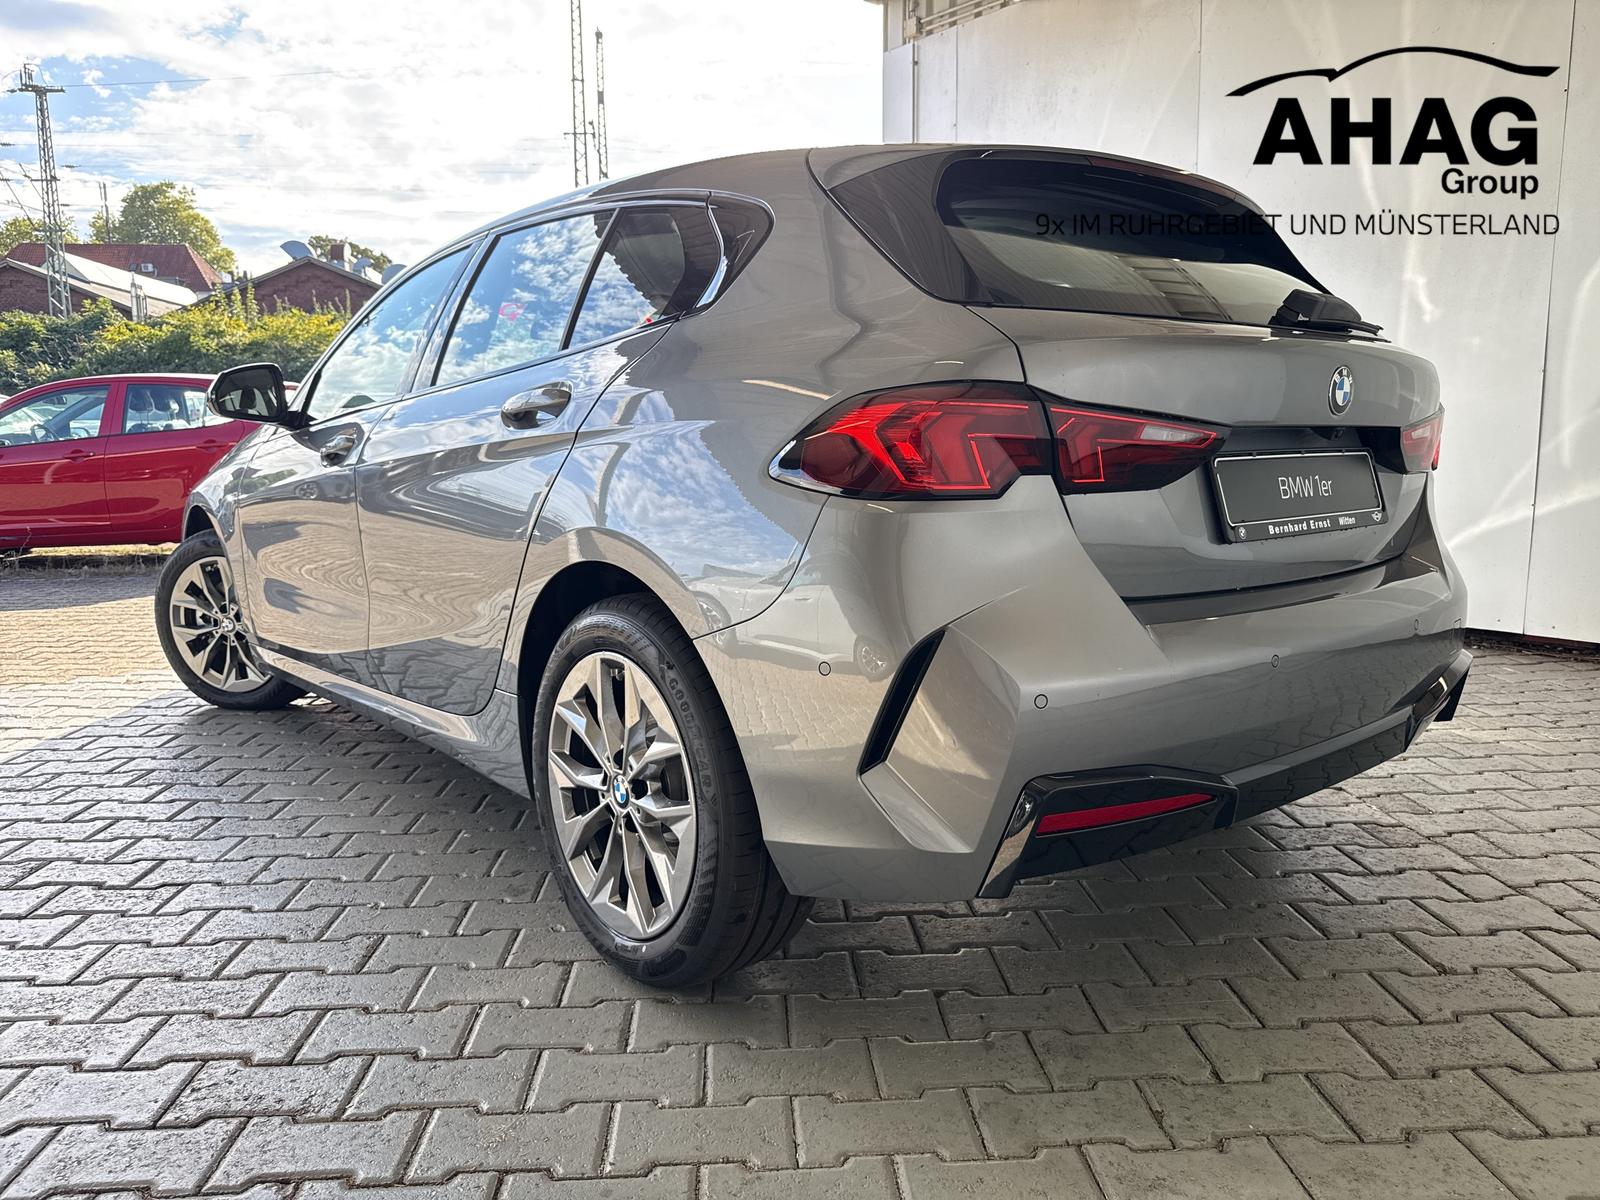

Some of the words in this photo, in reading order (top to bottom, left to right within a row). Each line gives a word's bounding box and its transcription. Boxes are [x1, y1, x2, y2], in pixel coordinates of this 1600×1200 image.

[1278, 475, 1313, 499] BMW
[1314, 475, 1332, 497] 1er
[1268, 520, 1308, 534] Bernhard
[1309, 518, 1331, 530] Ernst
[1338, 515, 1356, 526] Witten
